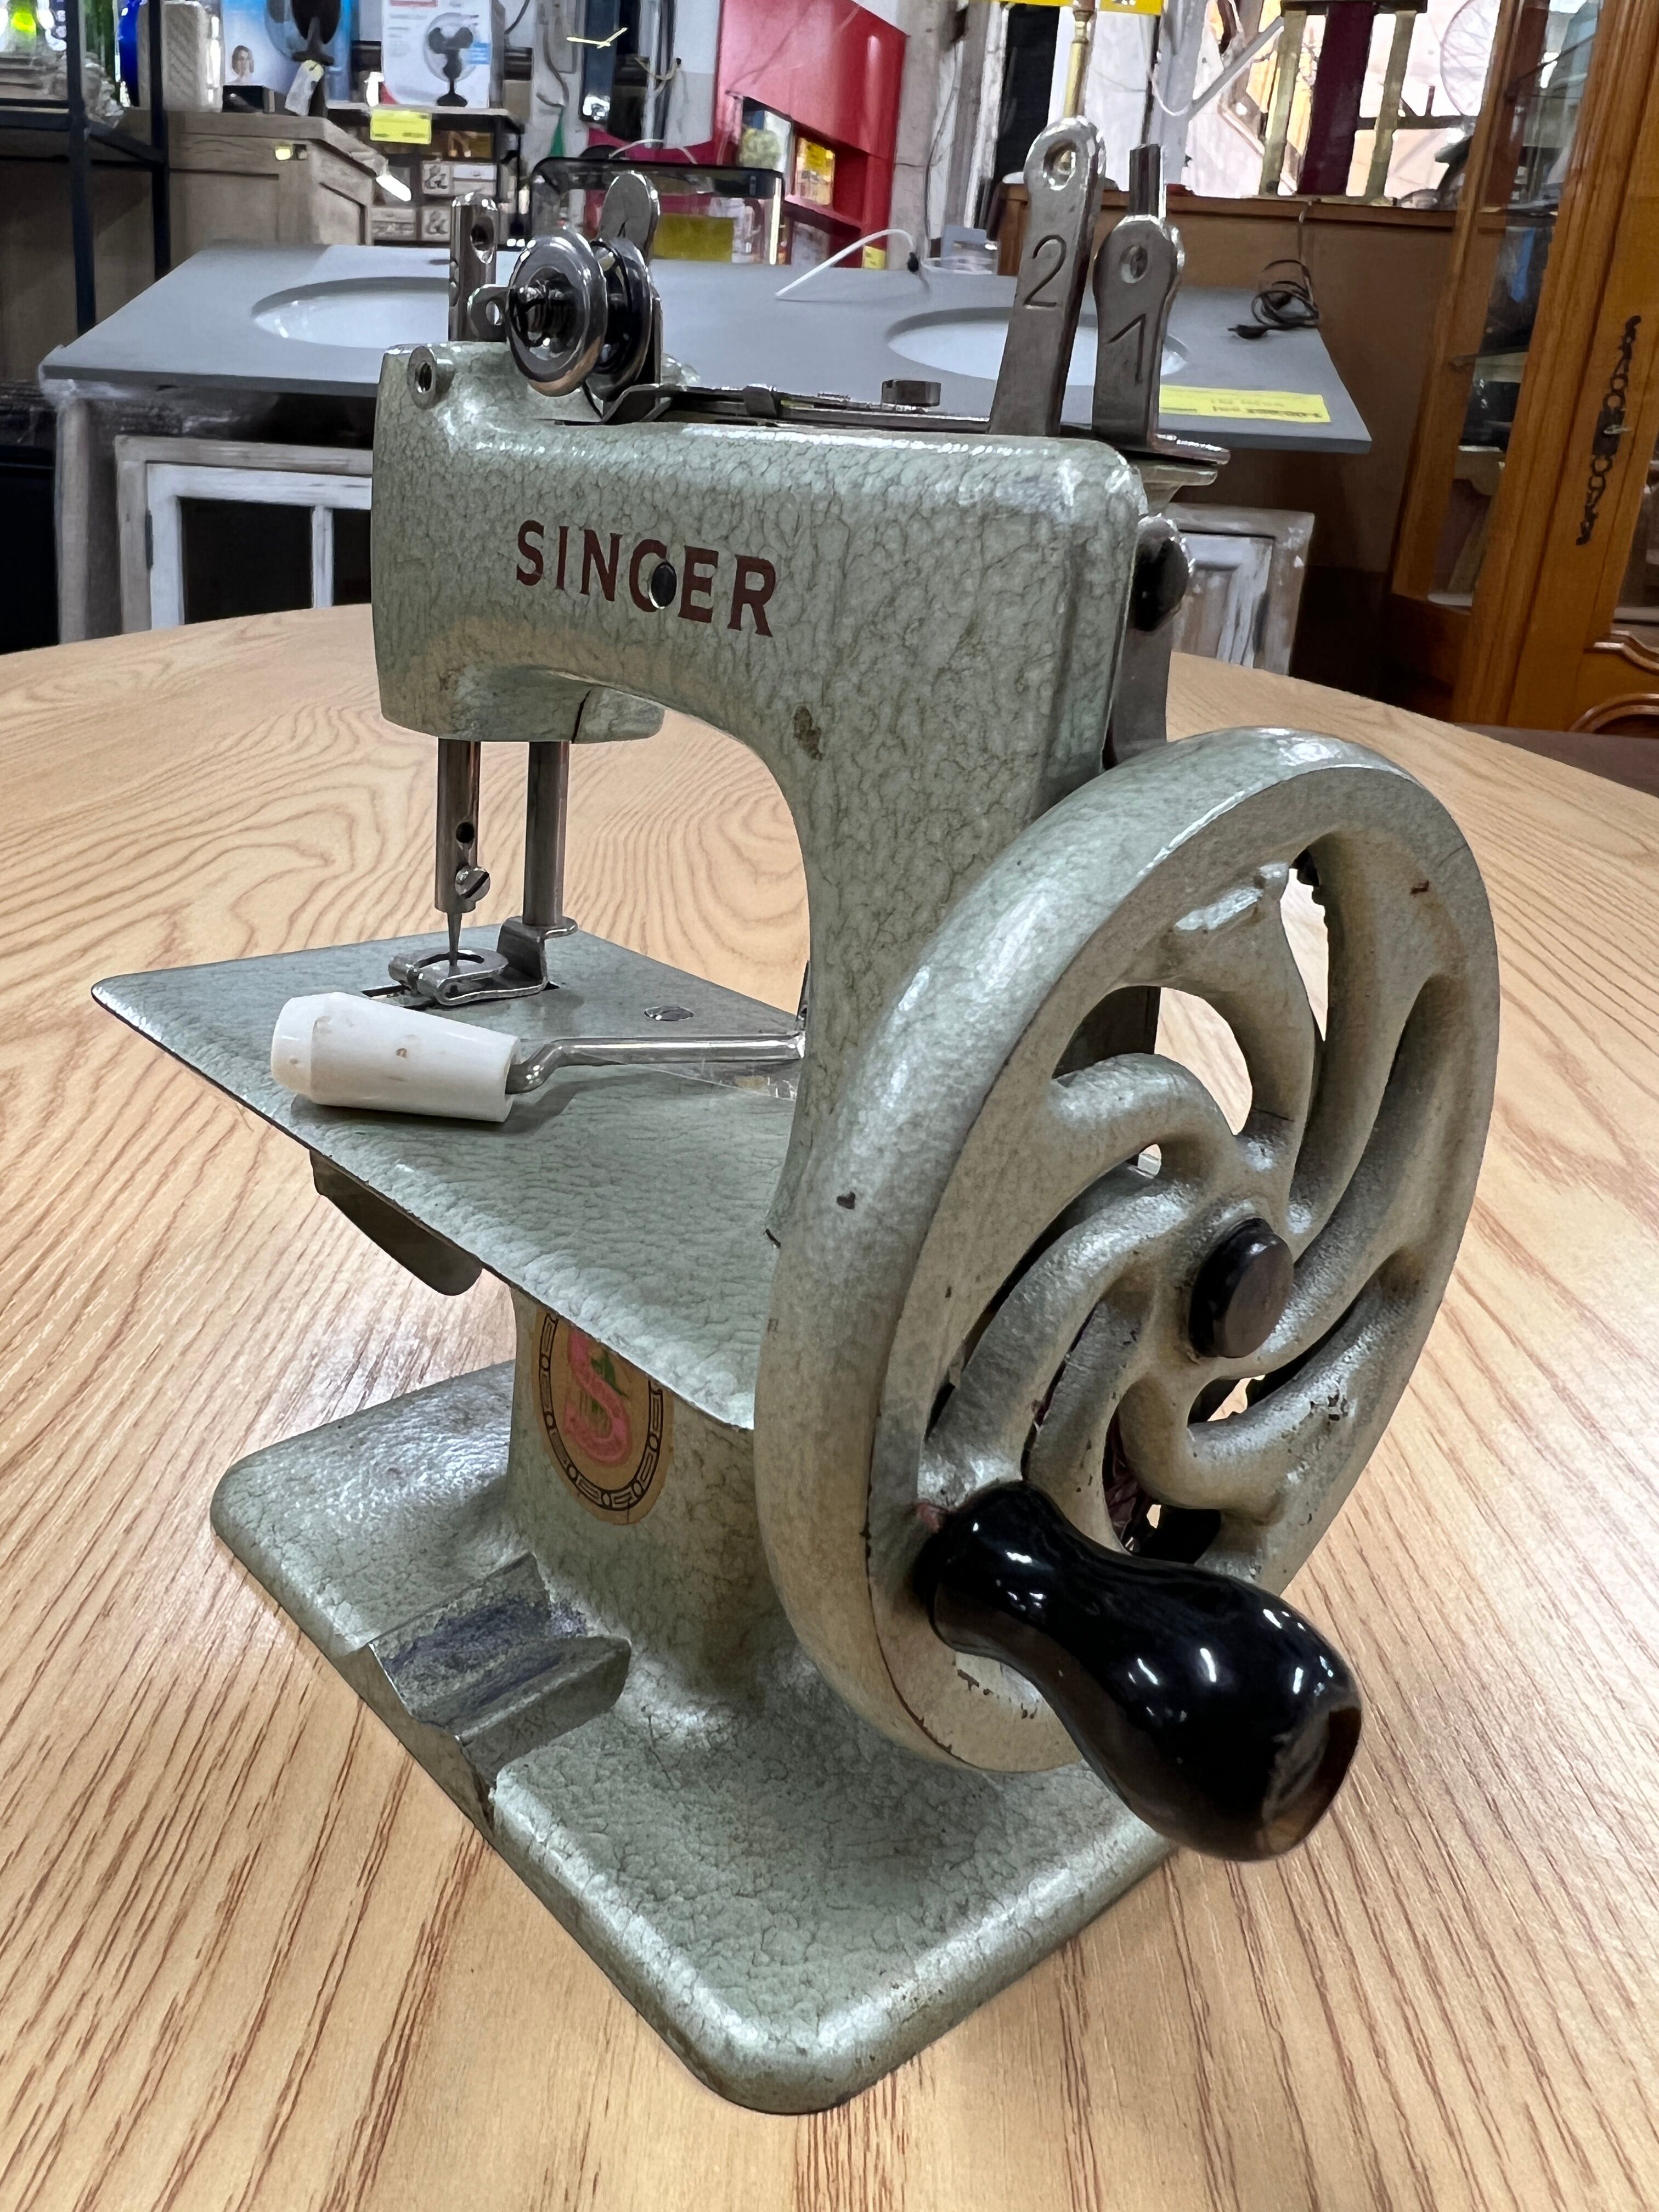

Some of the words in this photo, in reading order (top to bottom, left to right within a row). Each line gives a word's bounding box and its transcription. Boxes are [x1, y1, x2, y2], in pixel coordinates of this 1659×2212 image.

[1023, 235, 1066, 307] 2
[1105, 313, 1146, 385] 1
[516, 520, 776, 637] SINGER
